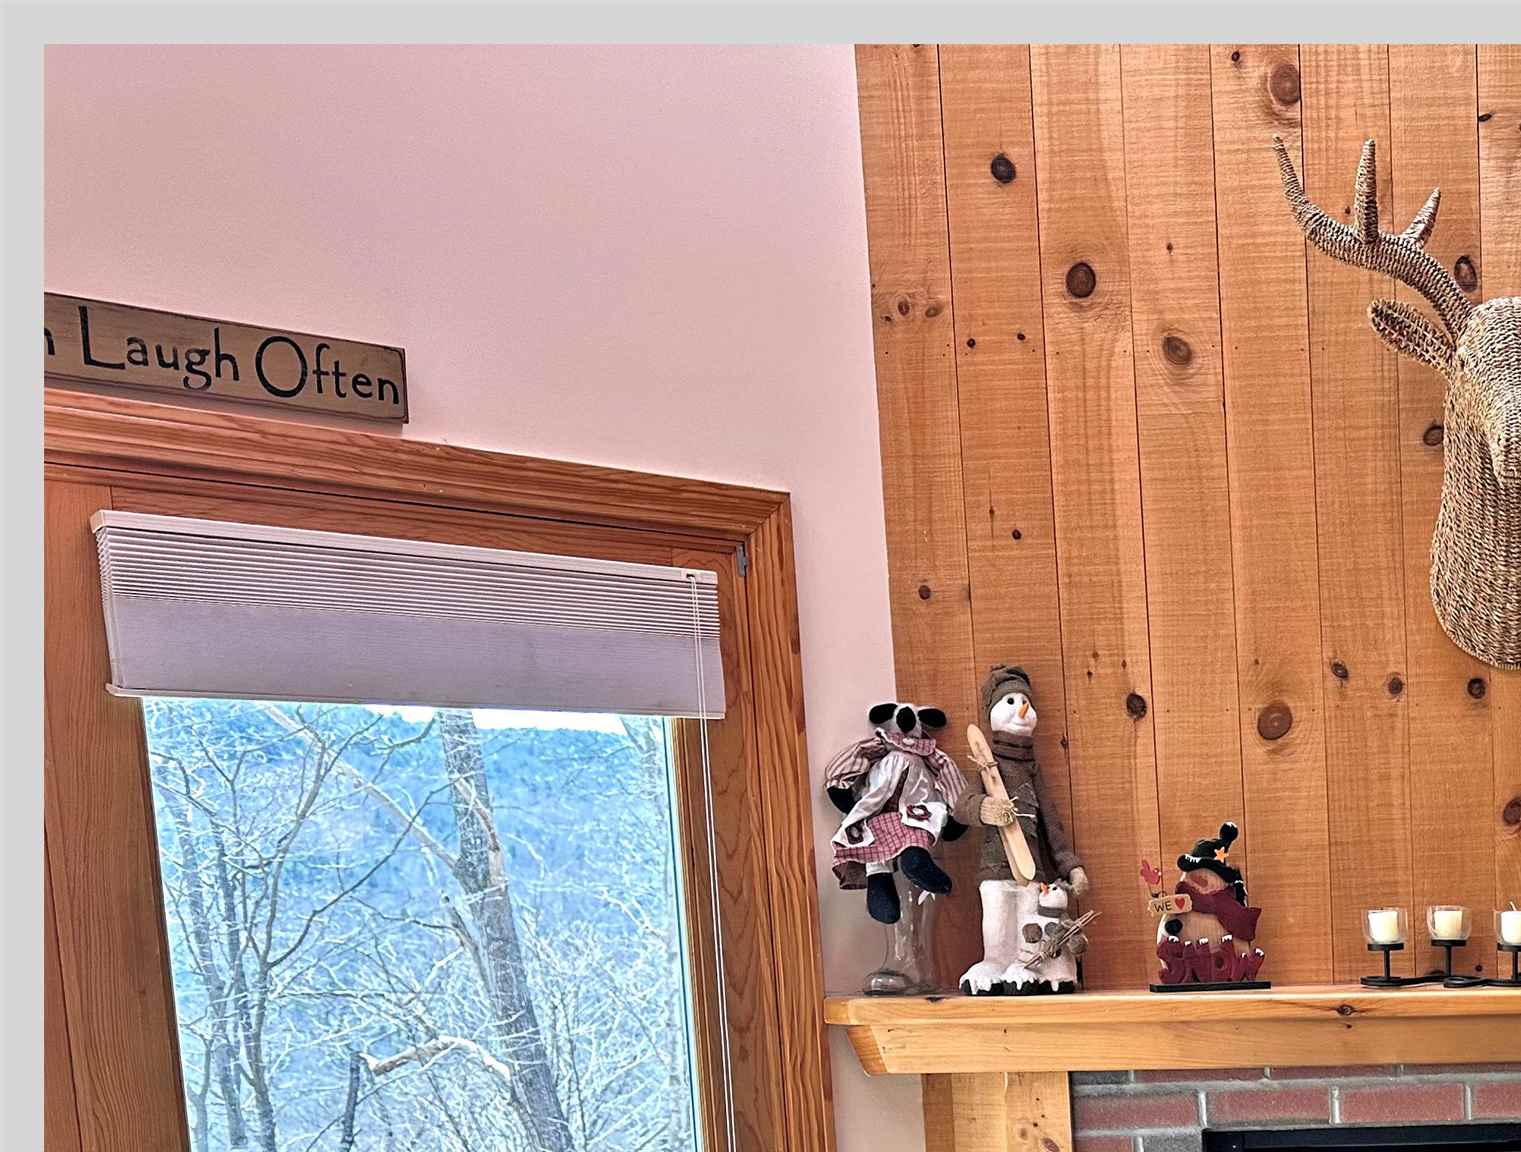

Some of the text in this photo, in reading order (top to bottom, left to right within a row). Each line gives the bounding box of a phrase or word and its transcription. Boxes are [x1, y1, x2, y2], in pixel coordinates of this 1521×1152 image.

[78, 305, 239, 392] Laugh
[255, 335, 399, 405] Often
[1154, 900, 1173, 912] WE
[1157, 934, 1265, 983] SNOW
